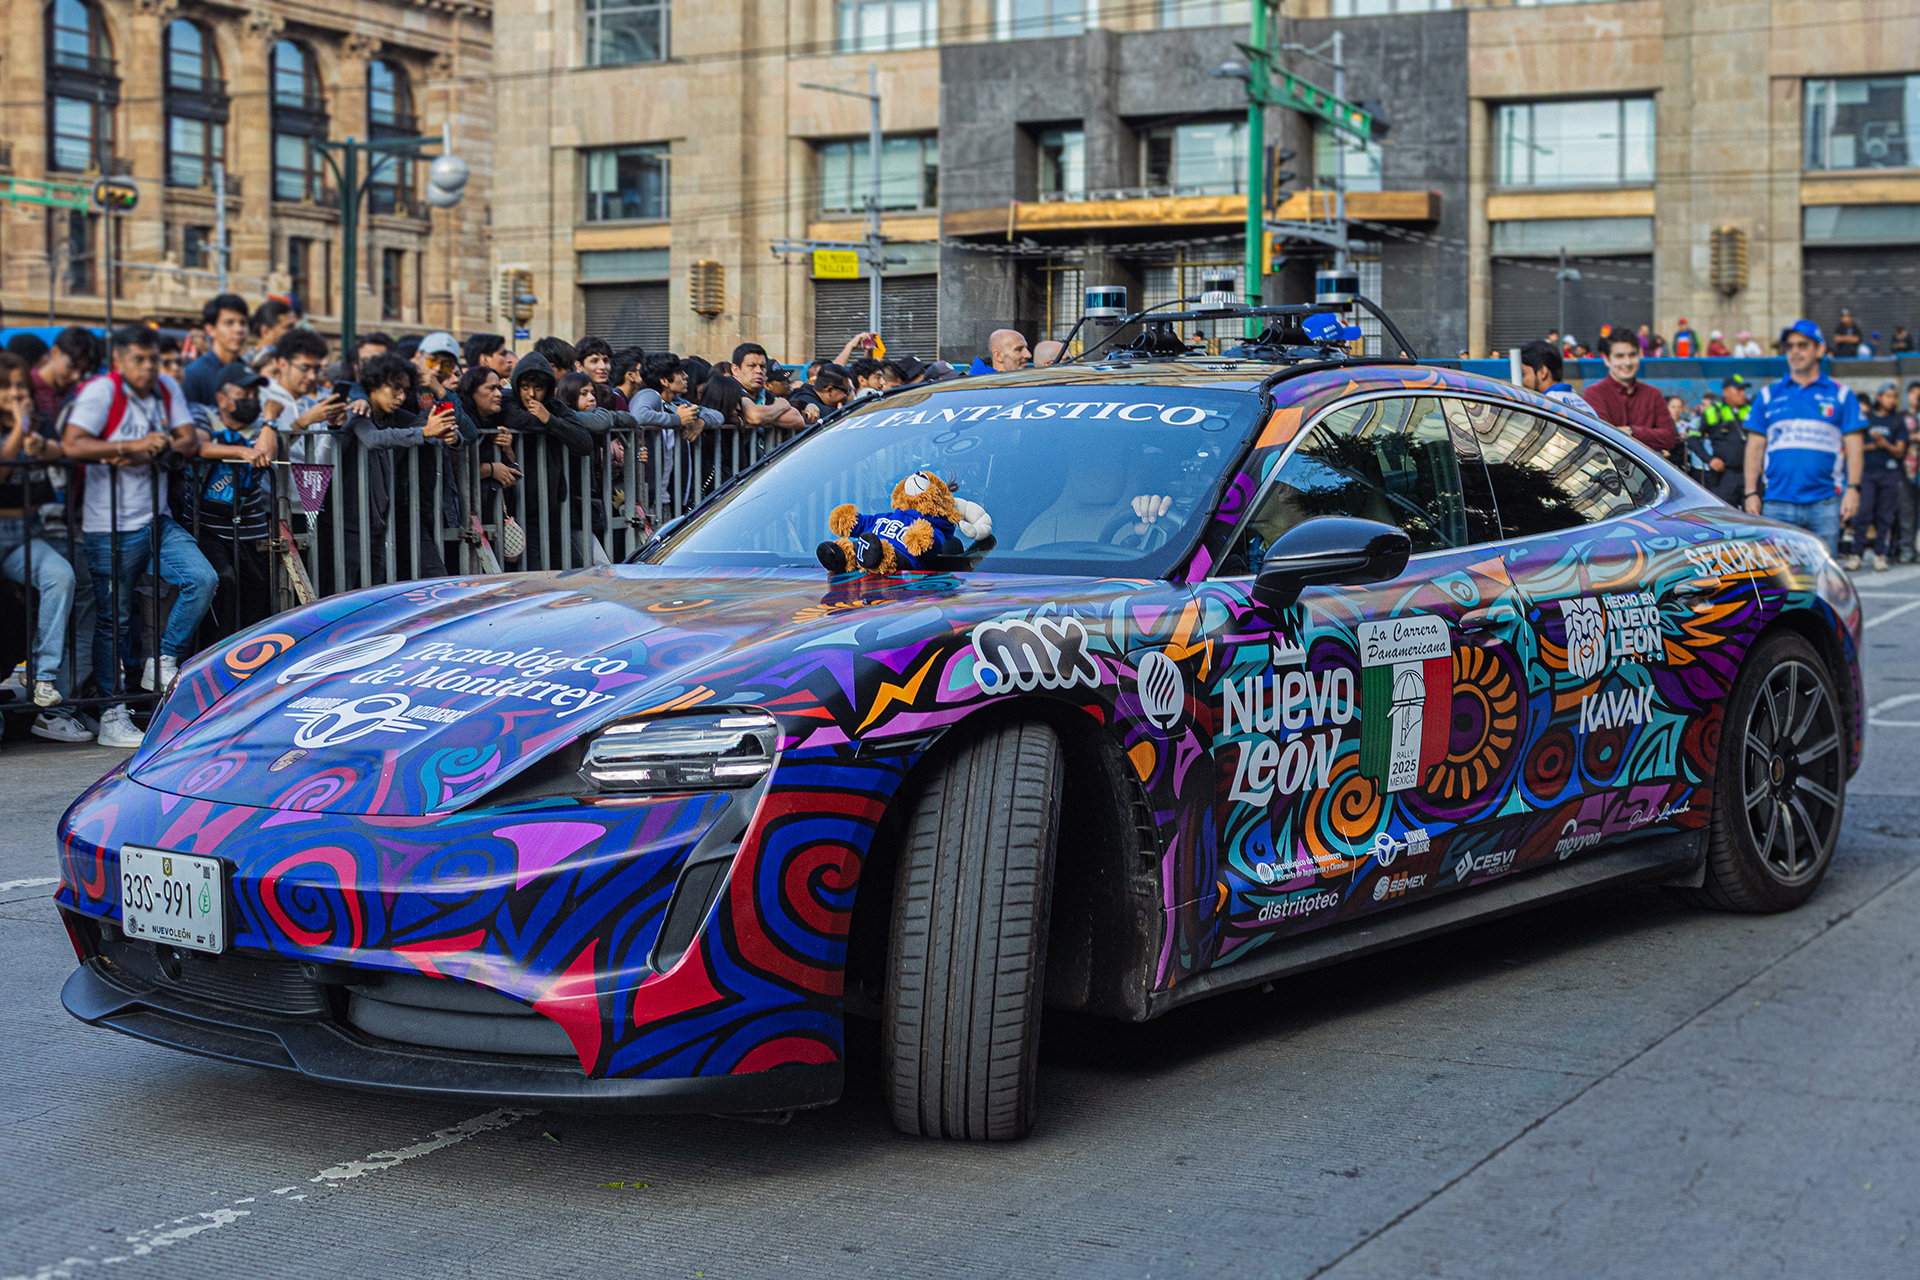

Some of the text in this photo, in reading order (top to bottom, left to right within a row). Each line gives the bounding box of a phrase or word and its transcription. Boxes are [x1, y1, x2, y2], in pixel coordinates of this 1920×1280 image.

[873, 399, 1206, 428] FANTÁSTICO
[857, 536, 870, 563] T
[1684, 540, 1779, 577] SEKURA
[1602, 592, 1657, 609] HECHO EN
[1607, 606, 1661, 629] NUEVO
[1368, 622, 1438, 642] La Carrera
[1610, 626, 1662, 657] LEÓN
[402, 642, 628, 678] Tecnológico
[1367, 641, 1447, 662] Panamericana
[350, 664, 616, 718] de Monterrey
[1579, 685, 1655, 734] KAVAK
[1396, 749, 1415, 759] RALLY
[1392, 759, 1417, 775] 2025
[1554, 832, 1602, 854] movyon
[1473, 849, 1516, 871] CESVI
[1389, 873, 1427, 893] SEMEX
[124, 872, 193, 920] 33S-991
